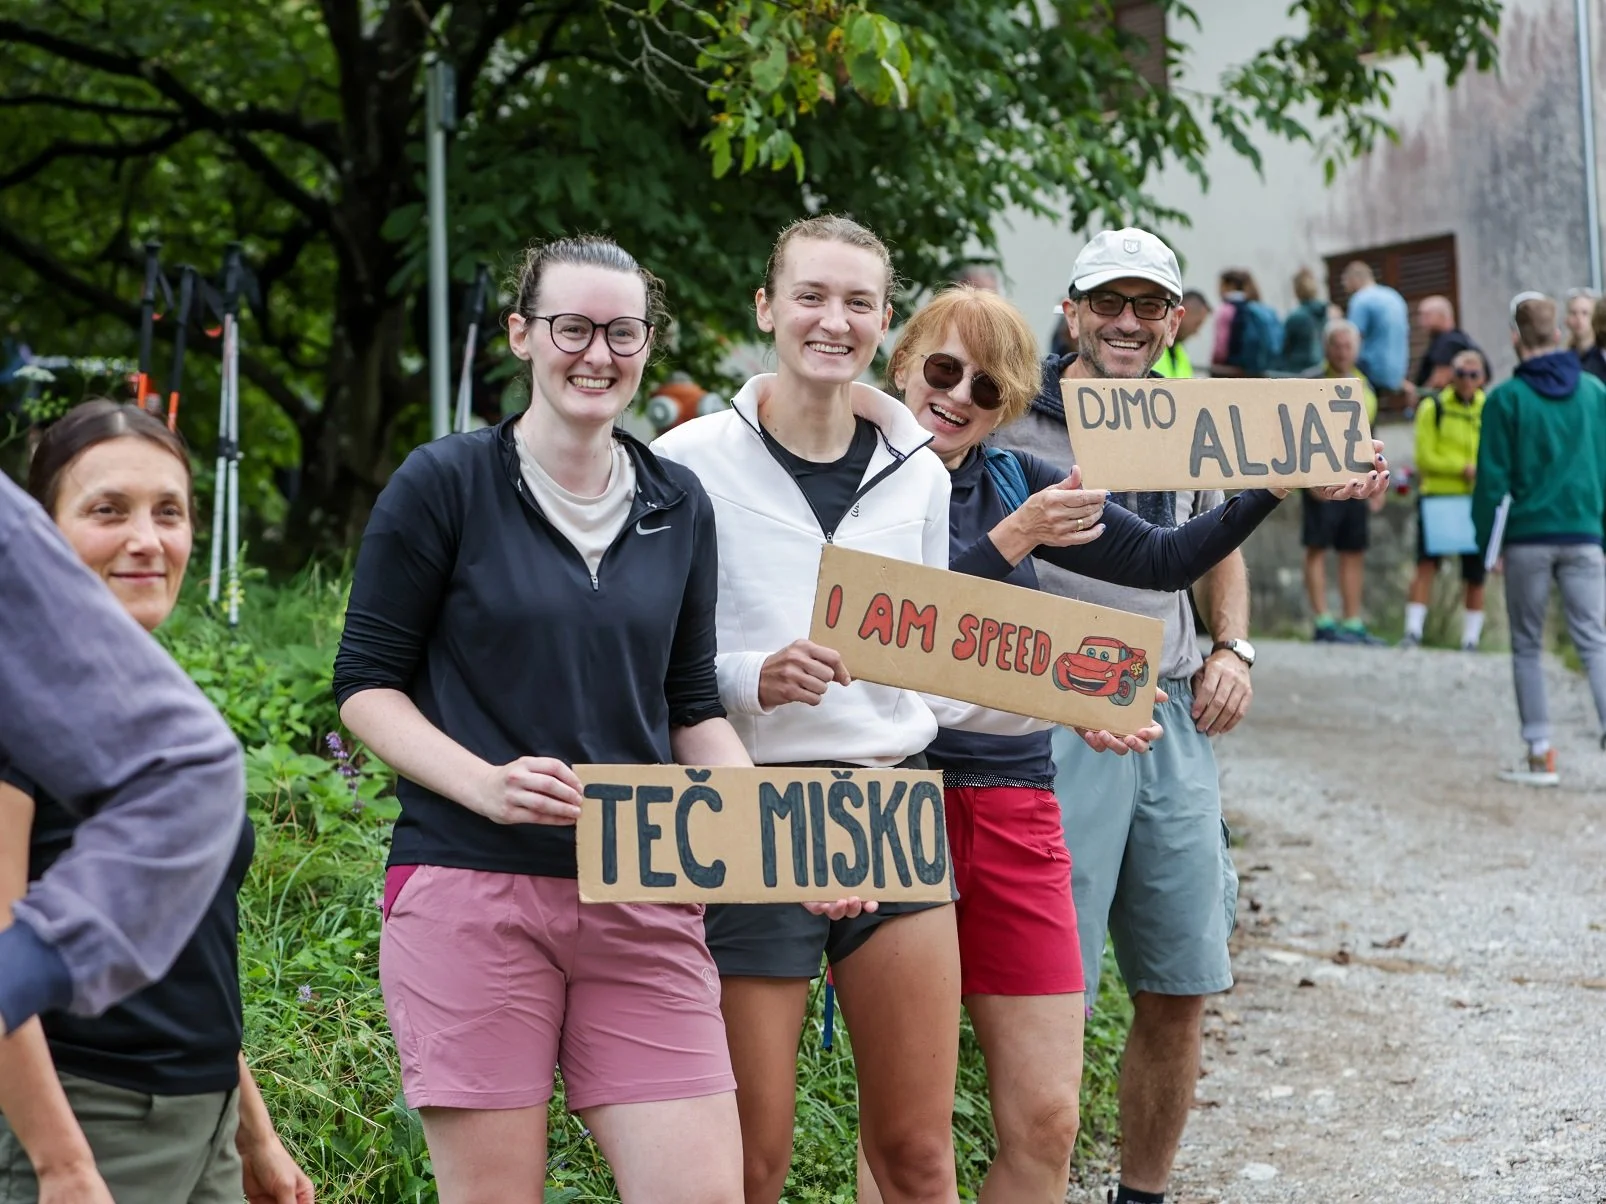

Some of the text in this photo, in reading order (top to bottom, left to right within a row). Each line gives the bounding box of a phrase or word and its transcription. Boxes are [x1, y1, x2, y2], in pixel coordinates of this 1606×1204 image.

[1077, 384, 1376, 478] DJMO ALJAŽ
[825, 584, 1052, 676] I AM SPEED
[1130, 662, 1143, 676] 95
[583, 768, 946, 888] TEČ MIŠKO
